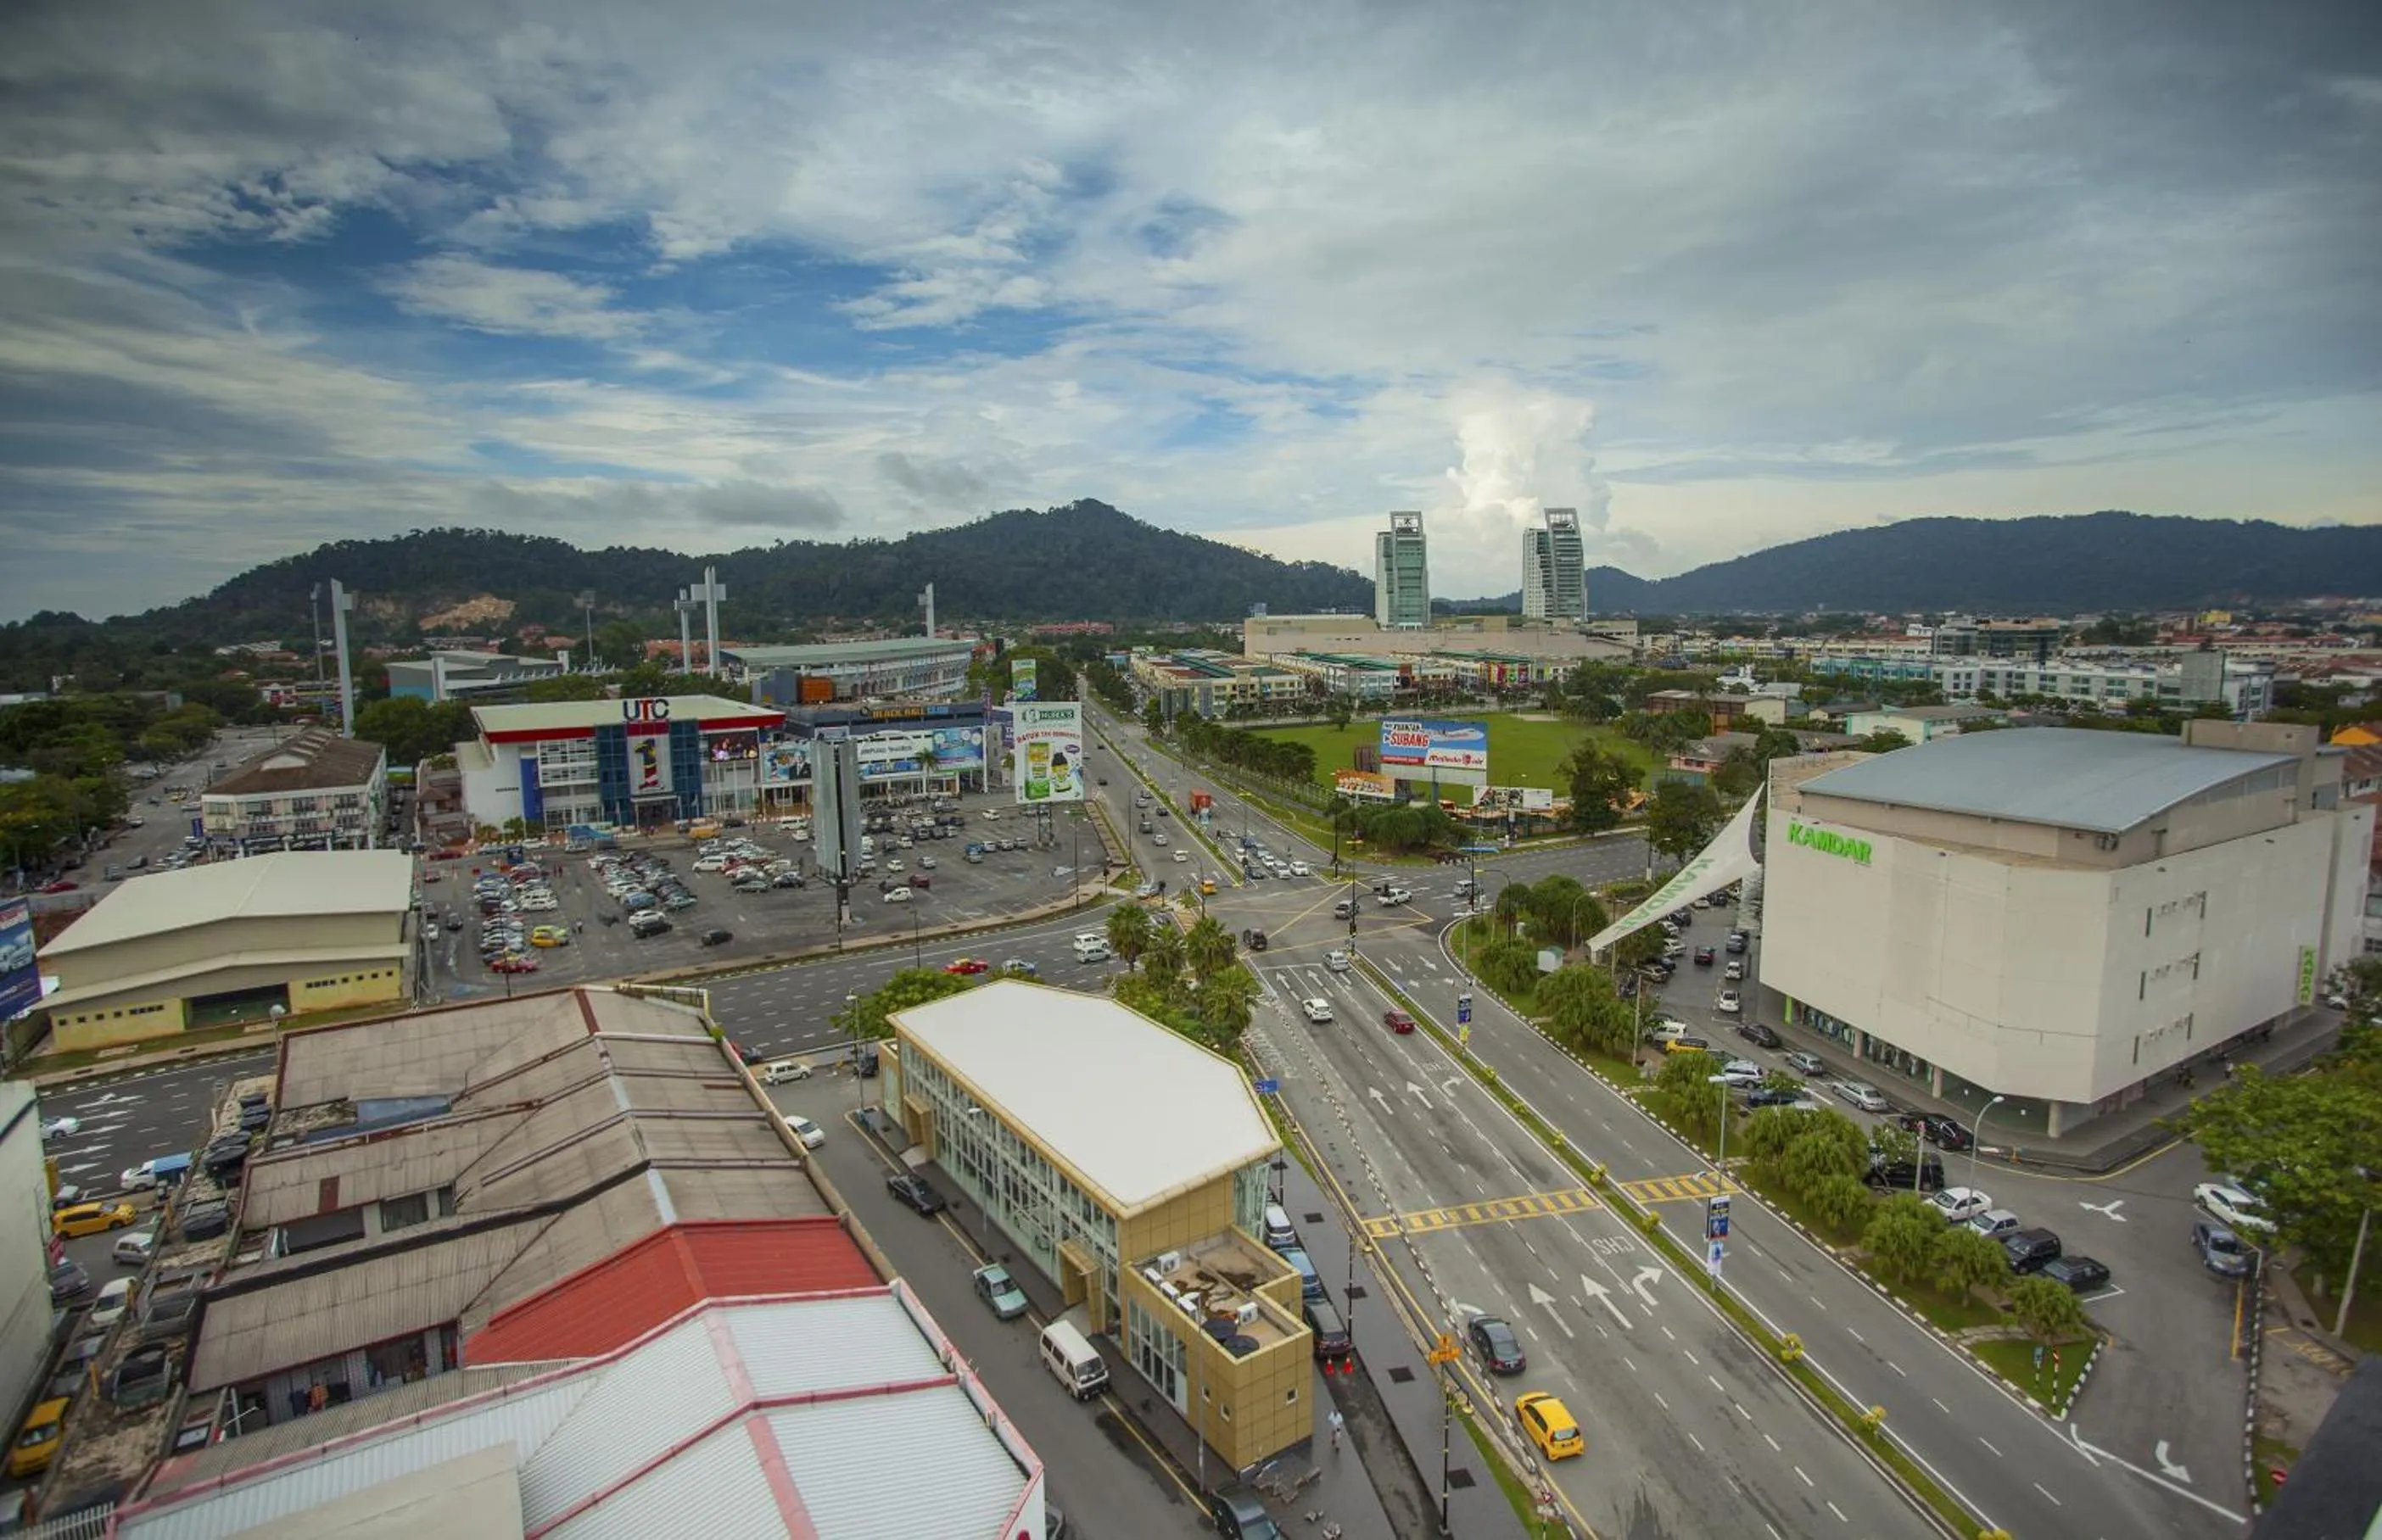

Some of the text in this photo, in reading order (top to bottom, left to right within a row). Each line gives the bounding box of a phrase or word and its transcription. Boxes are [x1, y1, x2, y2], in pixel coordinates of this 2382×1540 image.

[623, 698, 669, 721] UTC
[1390, 732, 1429, 747] SUBANG
[1788, 823, 1872, 863] KAMDAR
